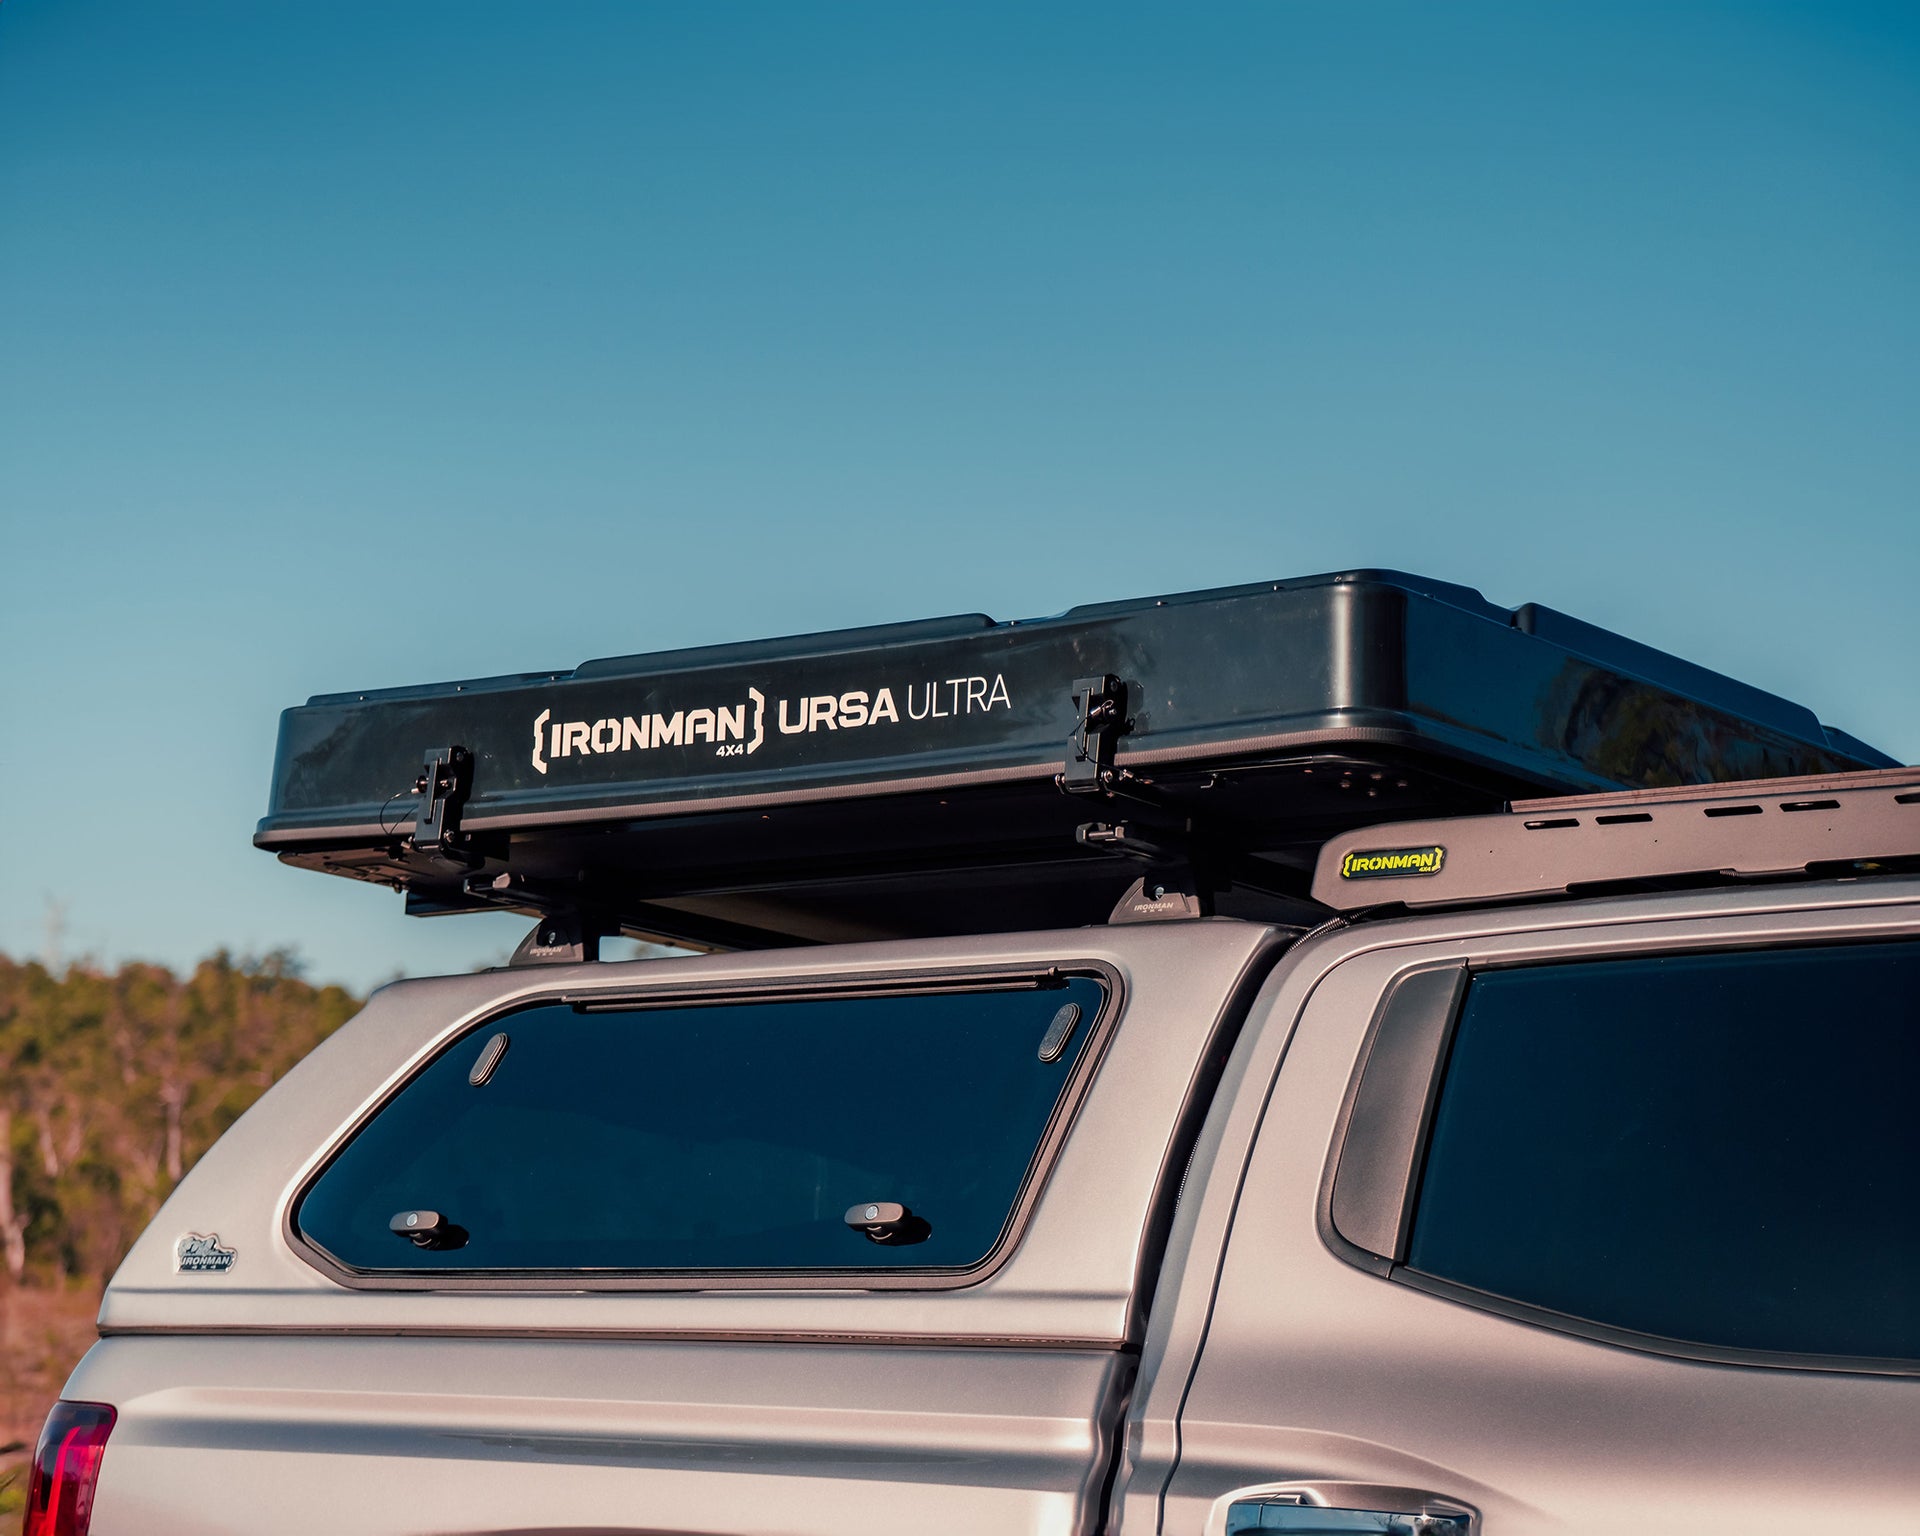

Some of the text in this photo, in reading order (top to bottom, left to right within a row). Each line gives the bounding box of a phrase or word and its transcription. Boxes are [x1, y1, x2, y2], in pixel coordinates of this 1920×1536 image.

[778, 687, 900, 735] URSA
[907, 673, 1012, 720] ULTRA
[1134, 902, 1174, 912] IRONMAN
[182, 1256, 230, 1265] IRONMAN
